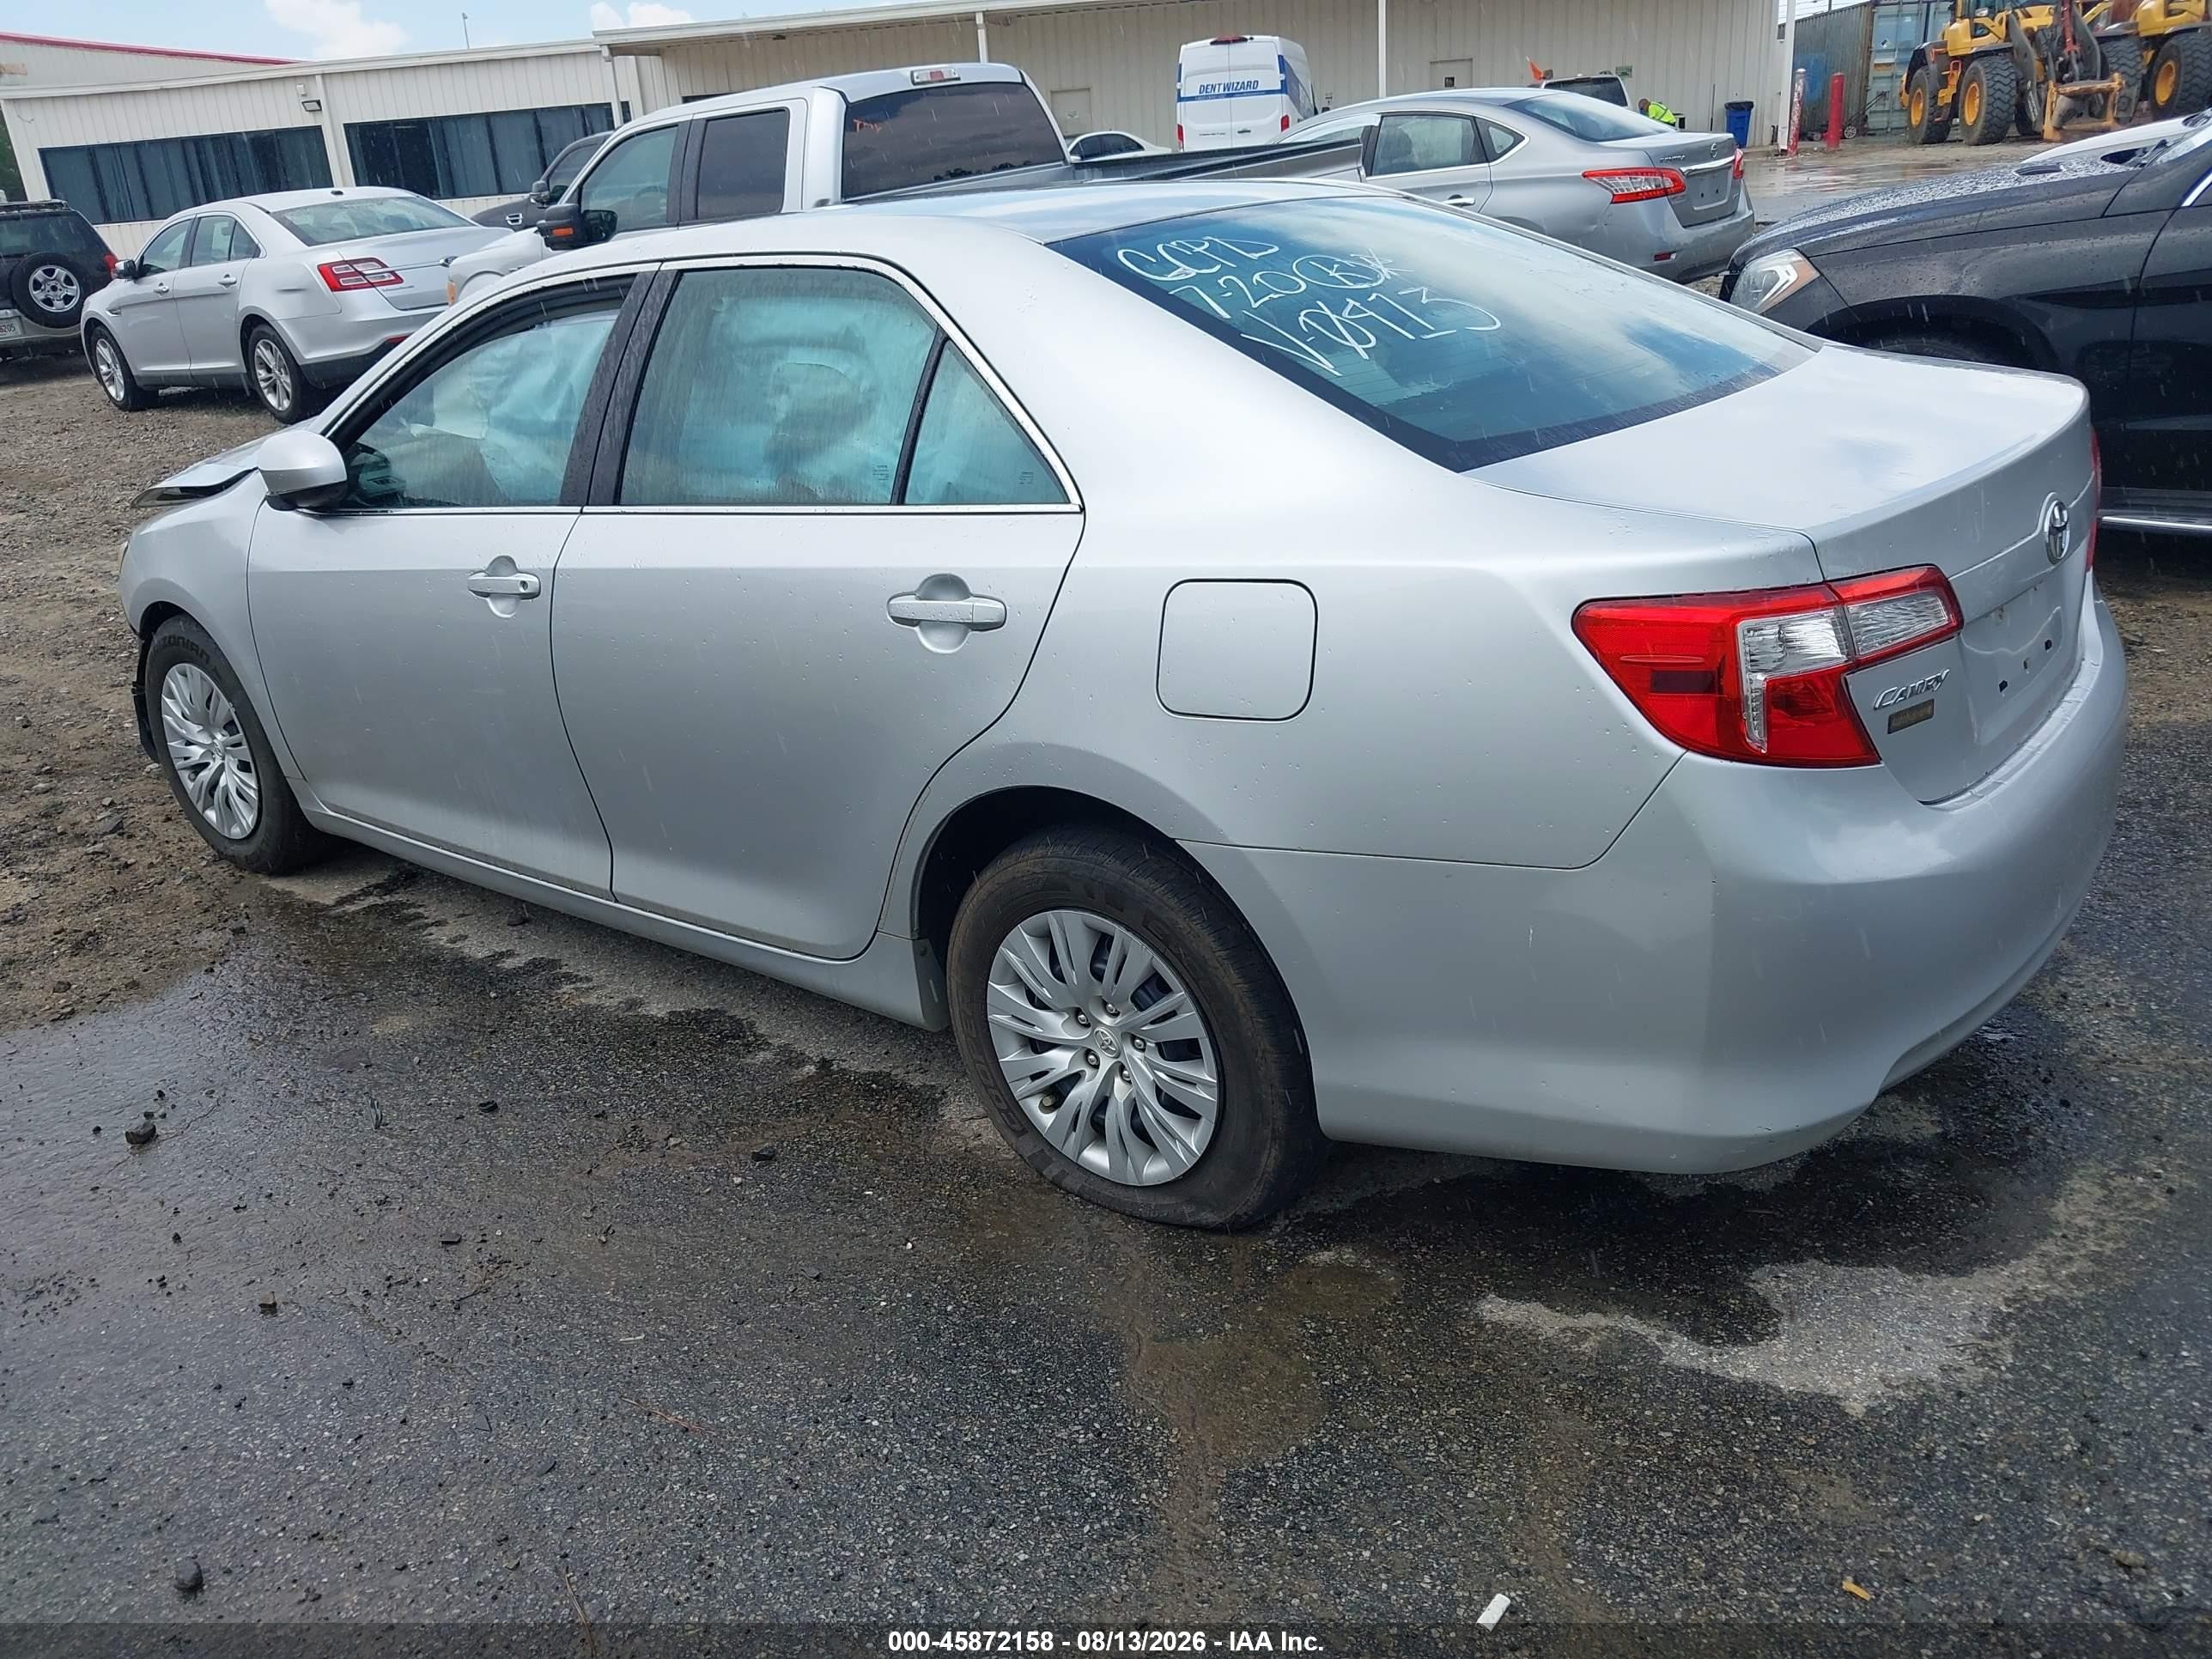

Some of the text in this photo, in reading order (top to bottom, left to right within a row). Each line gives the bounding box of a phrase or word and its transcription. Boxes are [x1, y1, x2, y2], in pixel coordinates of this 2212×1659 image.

[1199, 80, 1259, 94] DENT WIZARD
[1874, 668, 1950, 710] CAMRY
